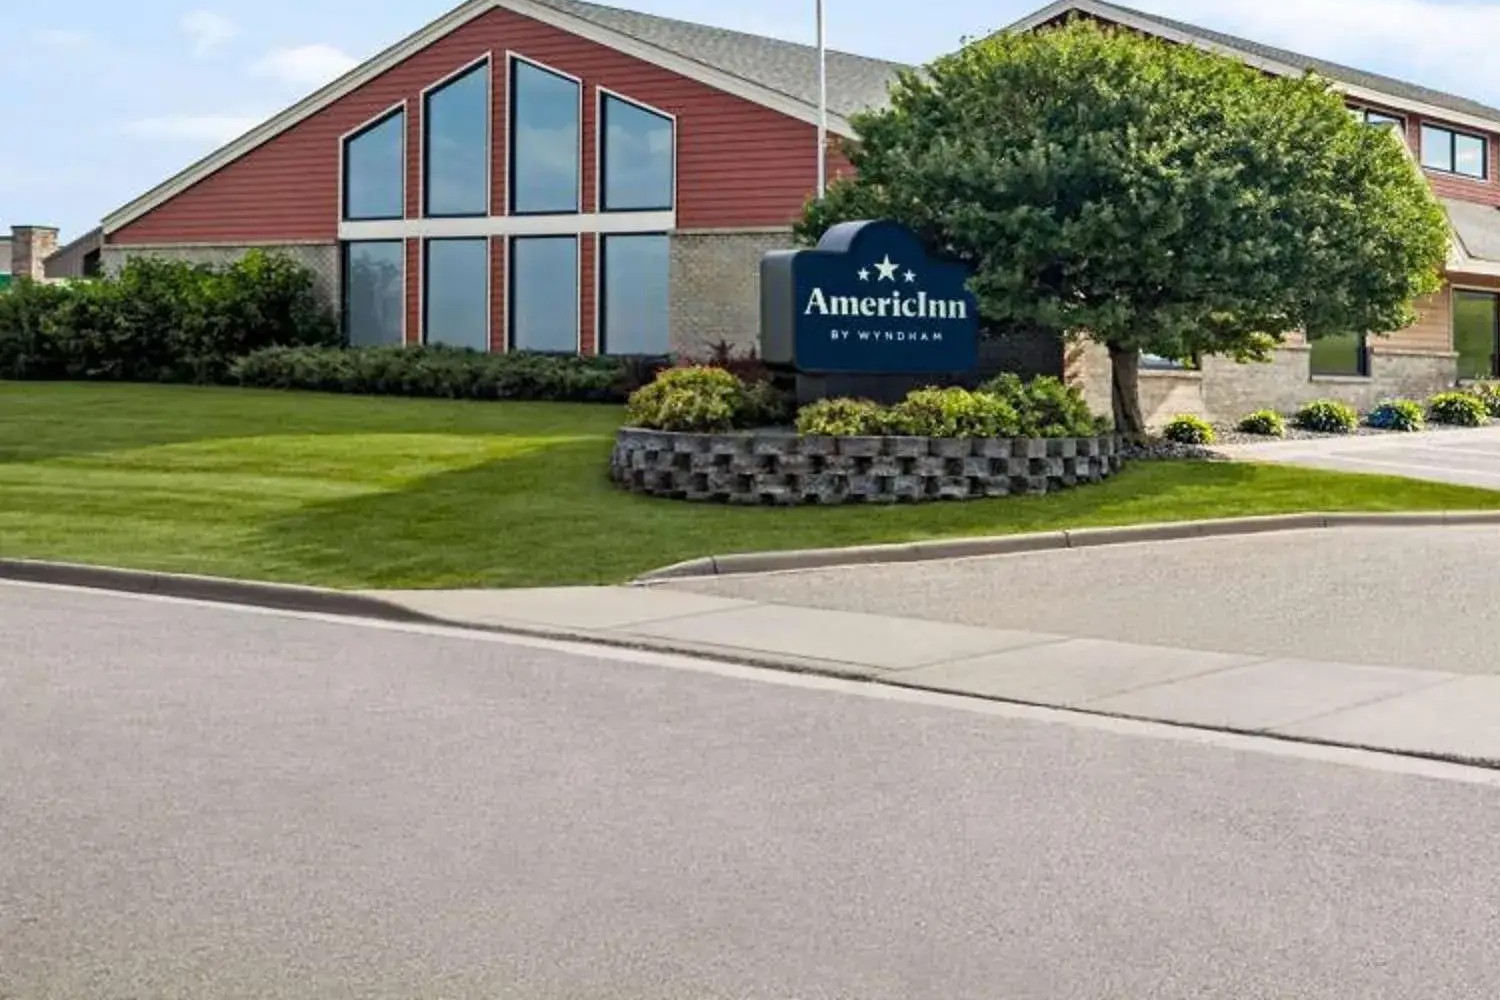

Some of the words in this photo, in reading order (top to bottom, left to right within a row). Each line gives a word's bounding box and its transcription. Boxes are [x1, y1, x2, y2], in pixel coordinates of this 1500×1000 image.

[804, 287, 968, 319] AmericInn
[830, 329, 850, 340] BY
[857, 329, 943, 341] WYNDHAM
